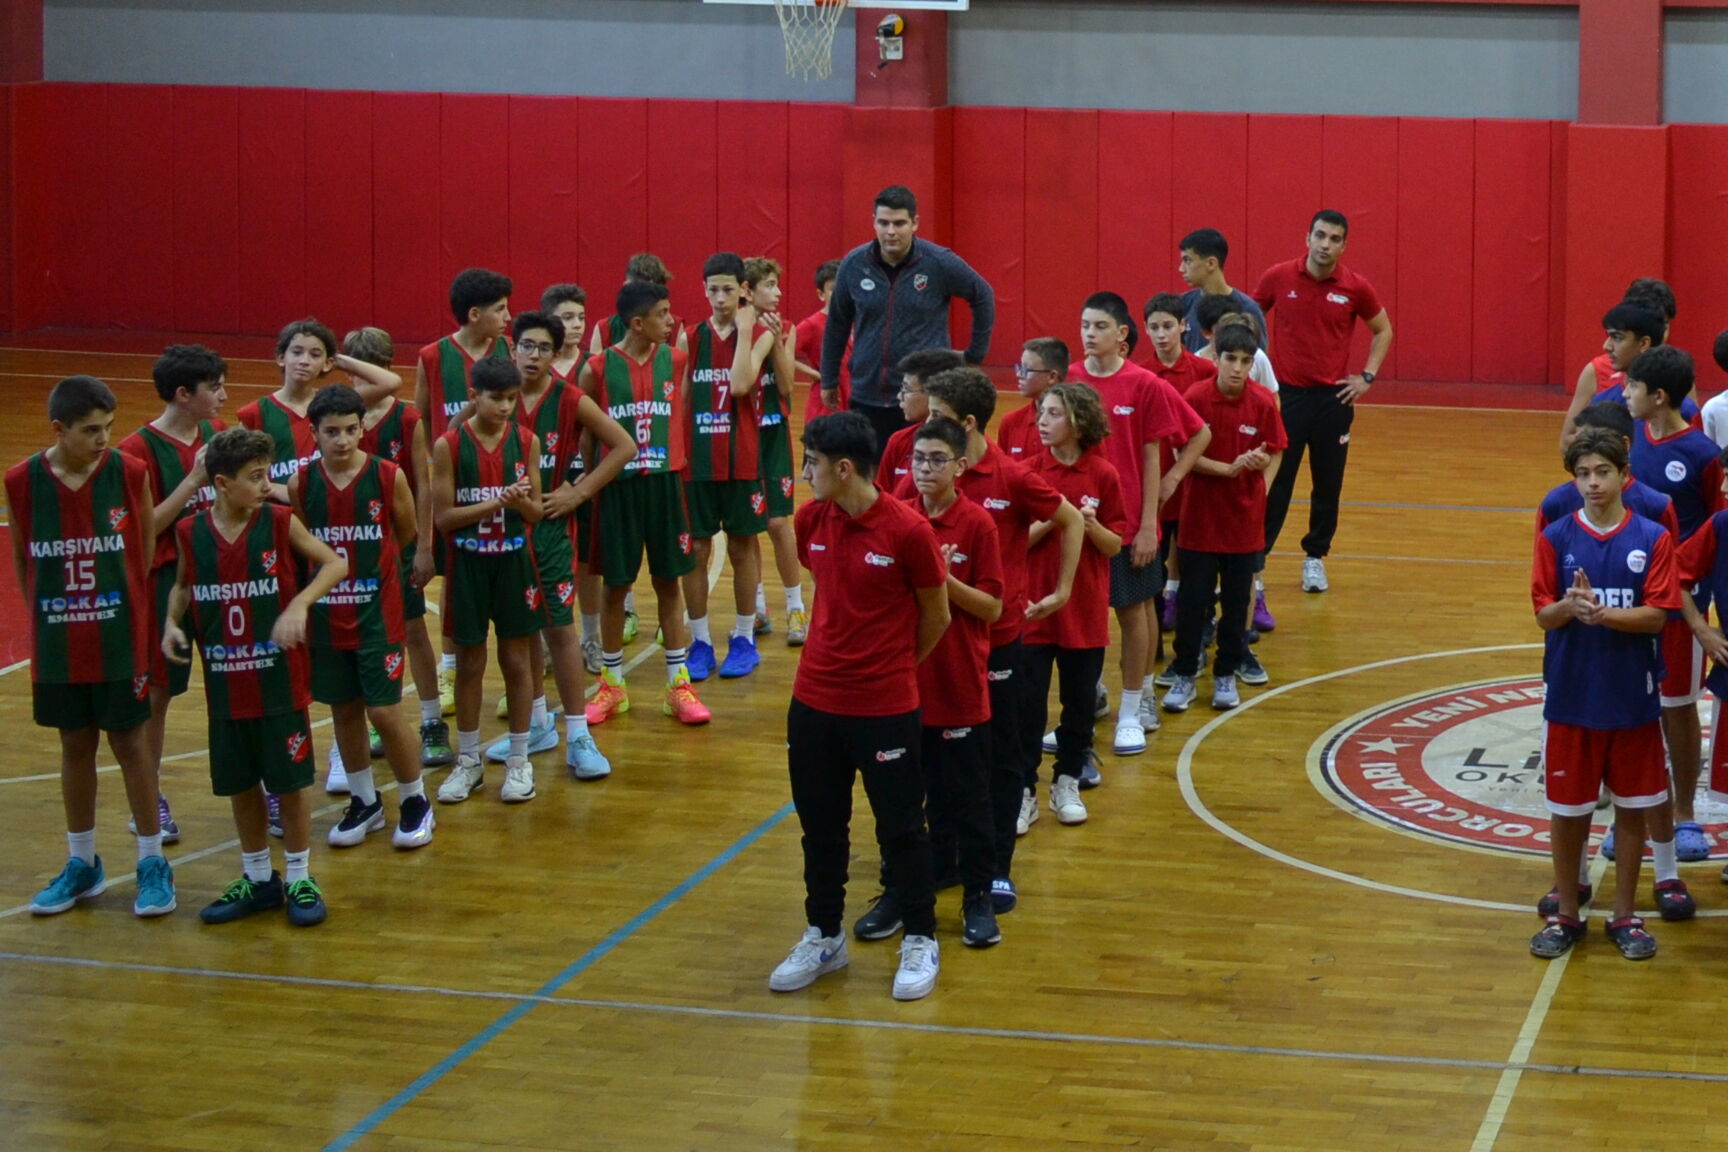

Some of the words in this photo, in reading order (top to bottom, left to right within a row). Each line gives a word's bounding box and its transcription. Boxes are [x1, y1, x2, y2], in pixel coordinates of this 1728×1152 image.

[718, 386, 728, 410] 7
[695, 411, 731, 424] TOLK
[29, 533, 125, 559] KARŞIYAKA
[309, 525, 383, 546] ARŞIYAKA
[64, 559, 96, 591] 15
[192, 576, 280, 603] KARŞIYAKA
[1593, 588, 1634, 609] DER
[39, 591, 123, 613] TOLKAR
[228, 605, 245, 636] 0
[204, 642, 280, 660] TOLKAR
[1391, 695, 1489, 729] YENİ
